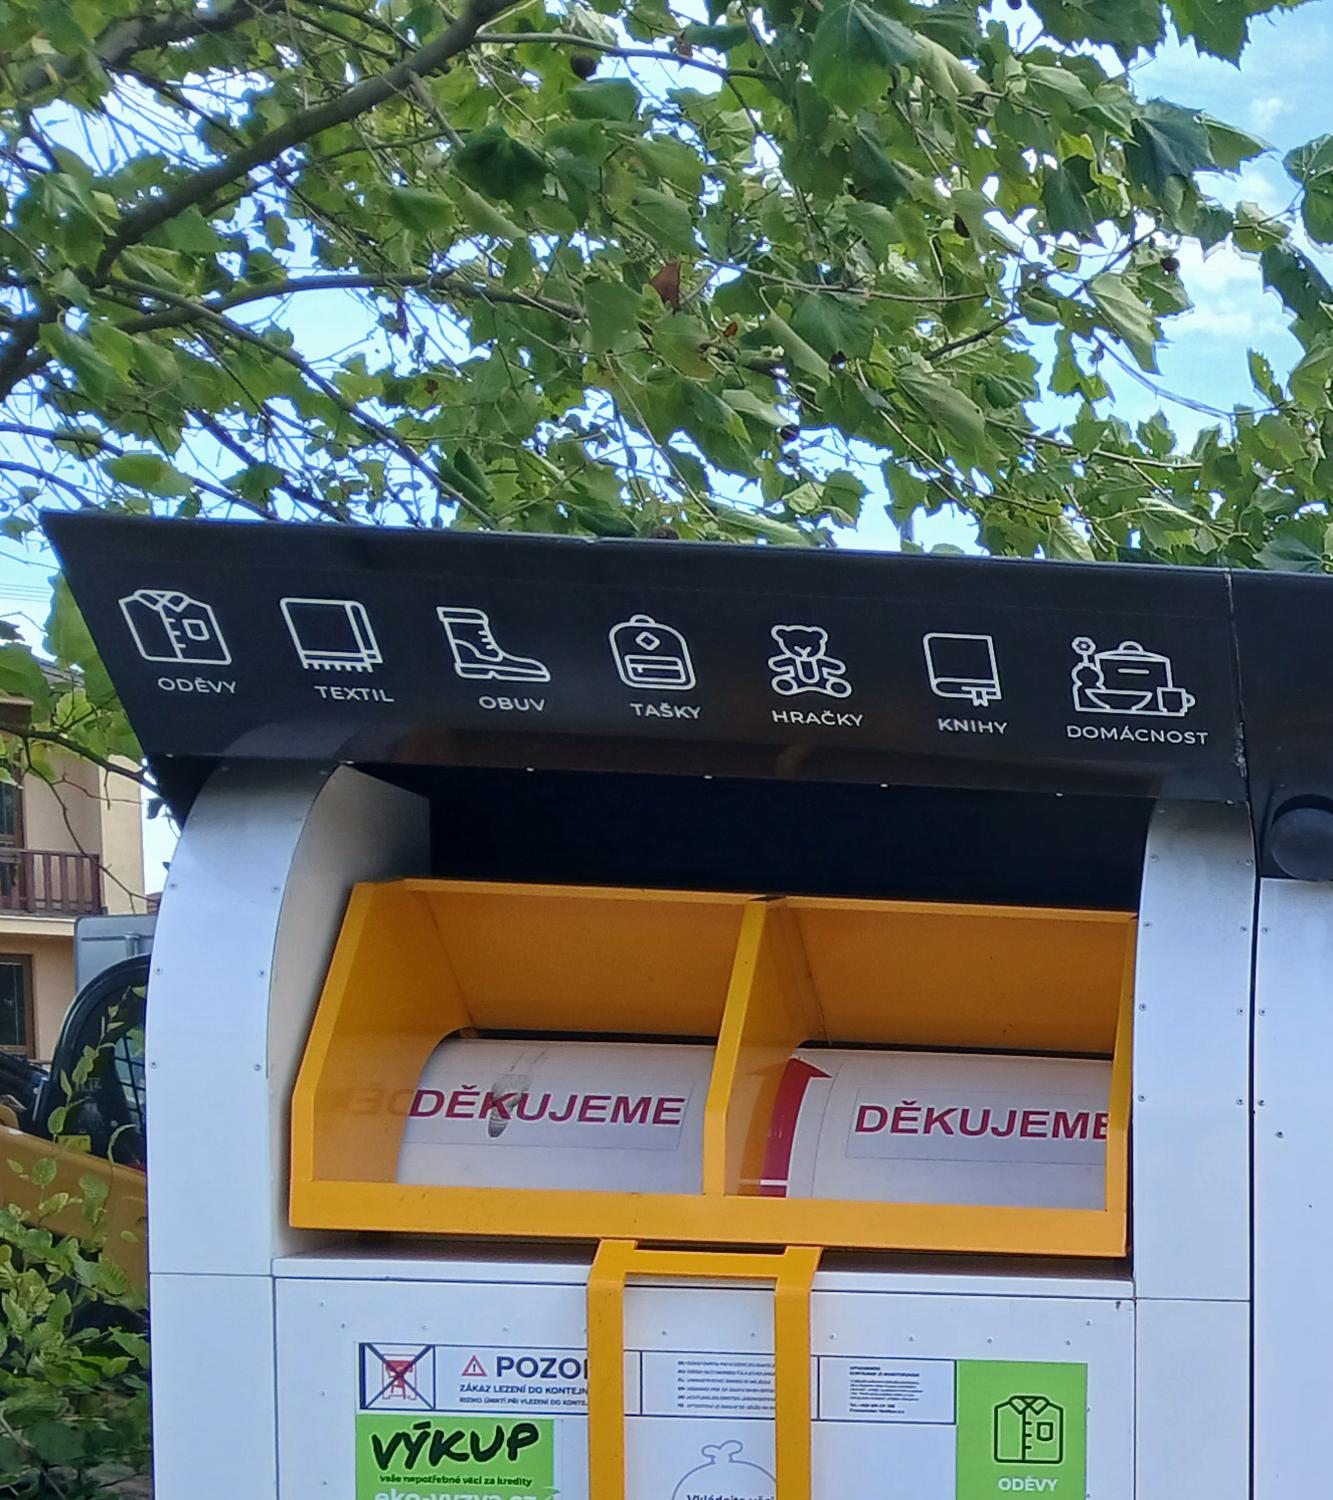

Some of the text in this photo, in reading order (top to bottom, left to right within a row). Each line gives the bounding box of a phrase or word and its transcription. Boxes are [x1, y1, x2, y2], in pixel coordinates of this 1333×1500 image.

[158, 676, 236, 695] ODĚVY
[314, 686, 394, 703] TEXTIL
[478, 696, 545, 712] OBUV
[631, 702, 700, 720] TAŠKY
[772, 709, 863, 727] HRAČKY
[938, 717, 1008, 735] KNIHY
[1066, 725, 1207, 745] DOMÁCNOST
[410, 1085, 685, 1125] DĚKUJEME
[460, 1383, 491, 1392] ZÁKAZ
[494, 1384, 526, 1393] LEZENÍ
[529, 1386, 542, 1394] DO
[372, 1421, 539, 1470] VÝKUP
[998, 1476, 1058, 1492] ODĚVY
